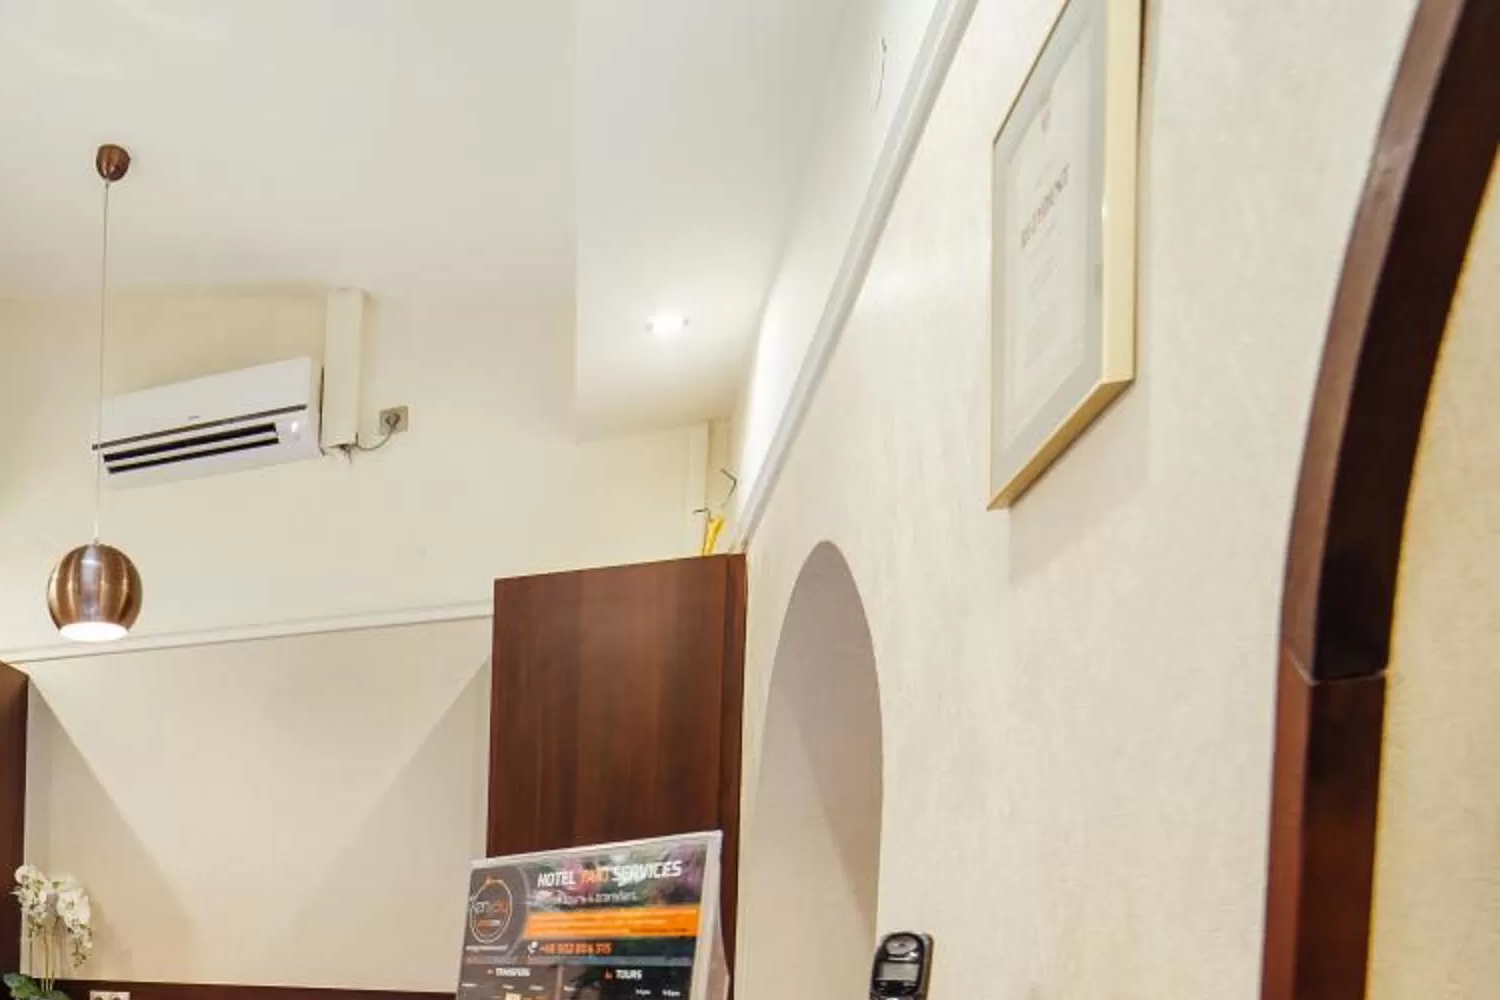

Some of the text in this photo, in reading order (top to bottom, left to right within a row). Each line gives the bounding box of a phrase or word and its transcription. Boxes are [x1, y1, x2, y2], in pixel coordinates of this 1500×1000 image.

[537, 870, 576, 888] HOTEL
[611, 861, 683, 885] SERVICES
[615, 969, 642, 979] TOURS
